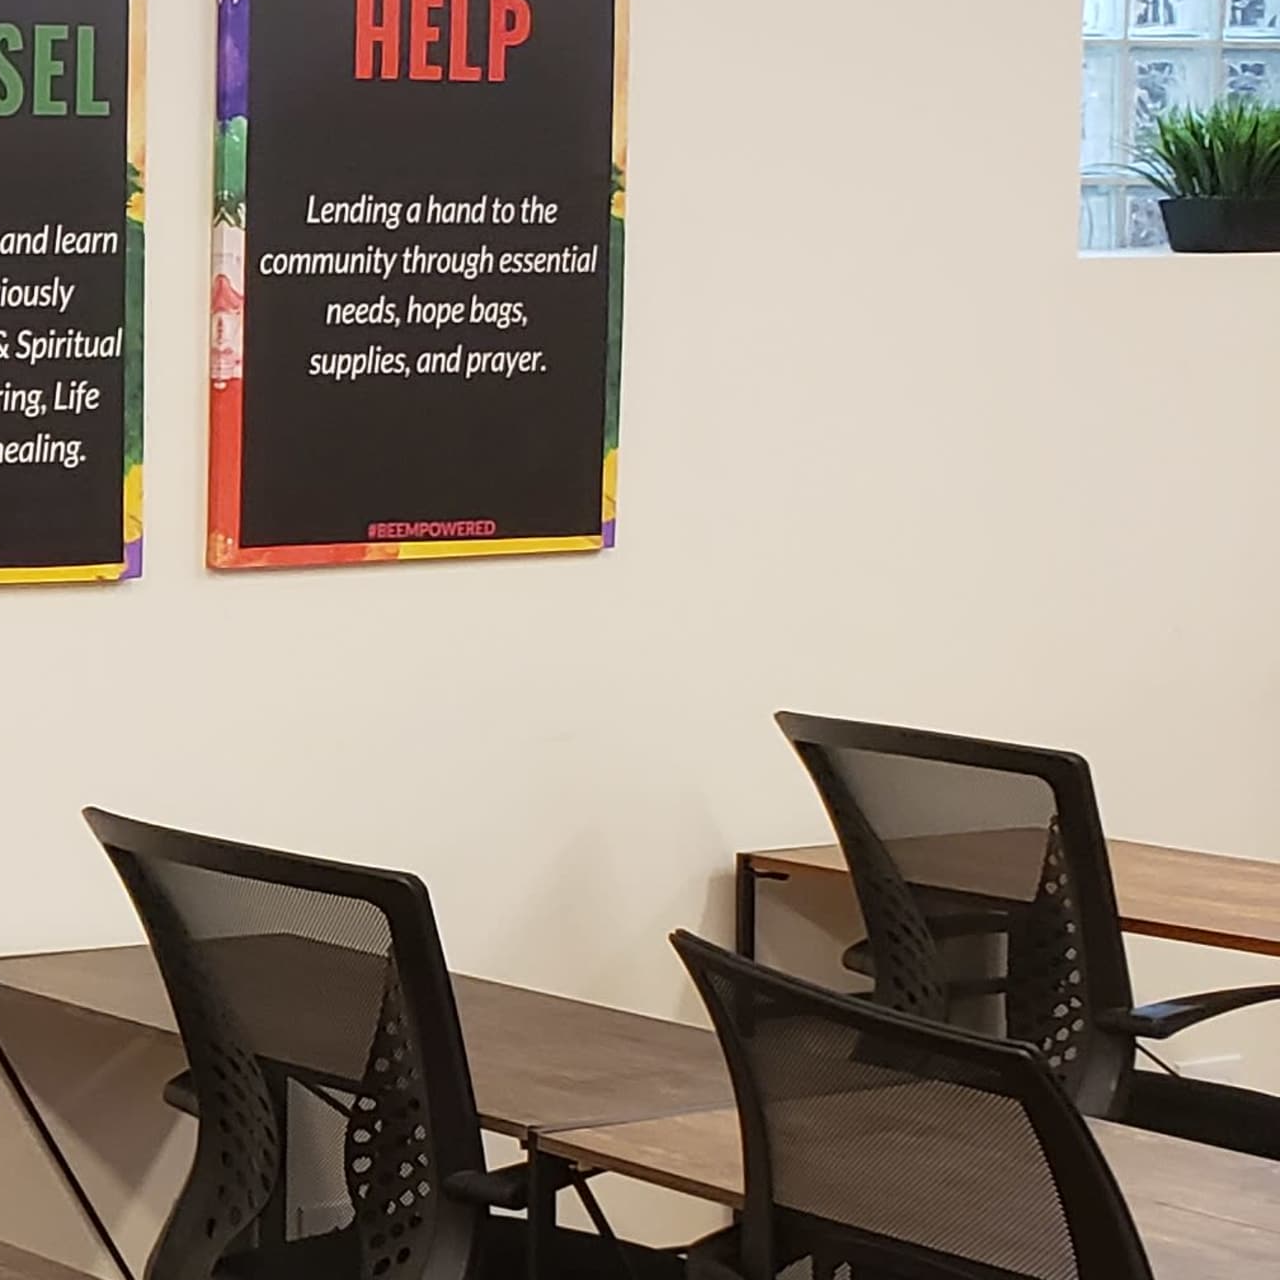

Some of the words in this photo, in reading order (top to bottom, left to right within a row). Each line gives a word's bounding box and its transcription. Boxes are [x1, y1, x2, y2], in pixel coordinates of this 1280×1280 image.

[307, 194, 402, 229] Lending
[407, 203, 421, 223] a
[427, 195, 487, 223] hand
[492, 198, 515, 223] to
[521, 195, 557, 223] the
[0, 225, 49, 254] and
[55, 224, 117, 254] learn
[260, 246, 397, 279] community
[403, 245, 493, 279] through
[500, 245, 597, 273] essential
[327, 295, 400, 327] needs,
[407, 295, 464, 329] hope
[470, 295, 527, 328] bags,
[16, 328, 122, 365] Spiritual
[309, 345, 410, 380] supplies,
[417, 344, 462, 373] and
[466, 352, 546, 378] prayer.
[54, 381, 99, 414] Life
[368, 520, 496, 538] #BEEMPOWERED
